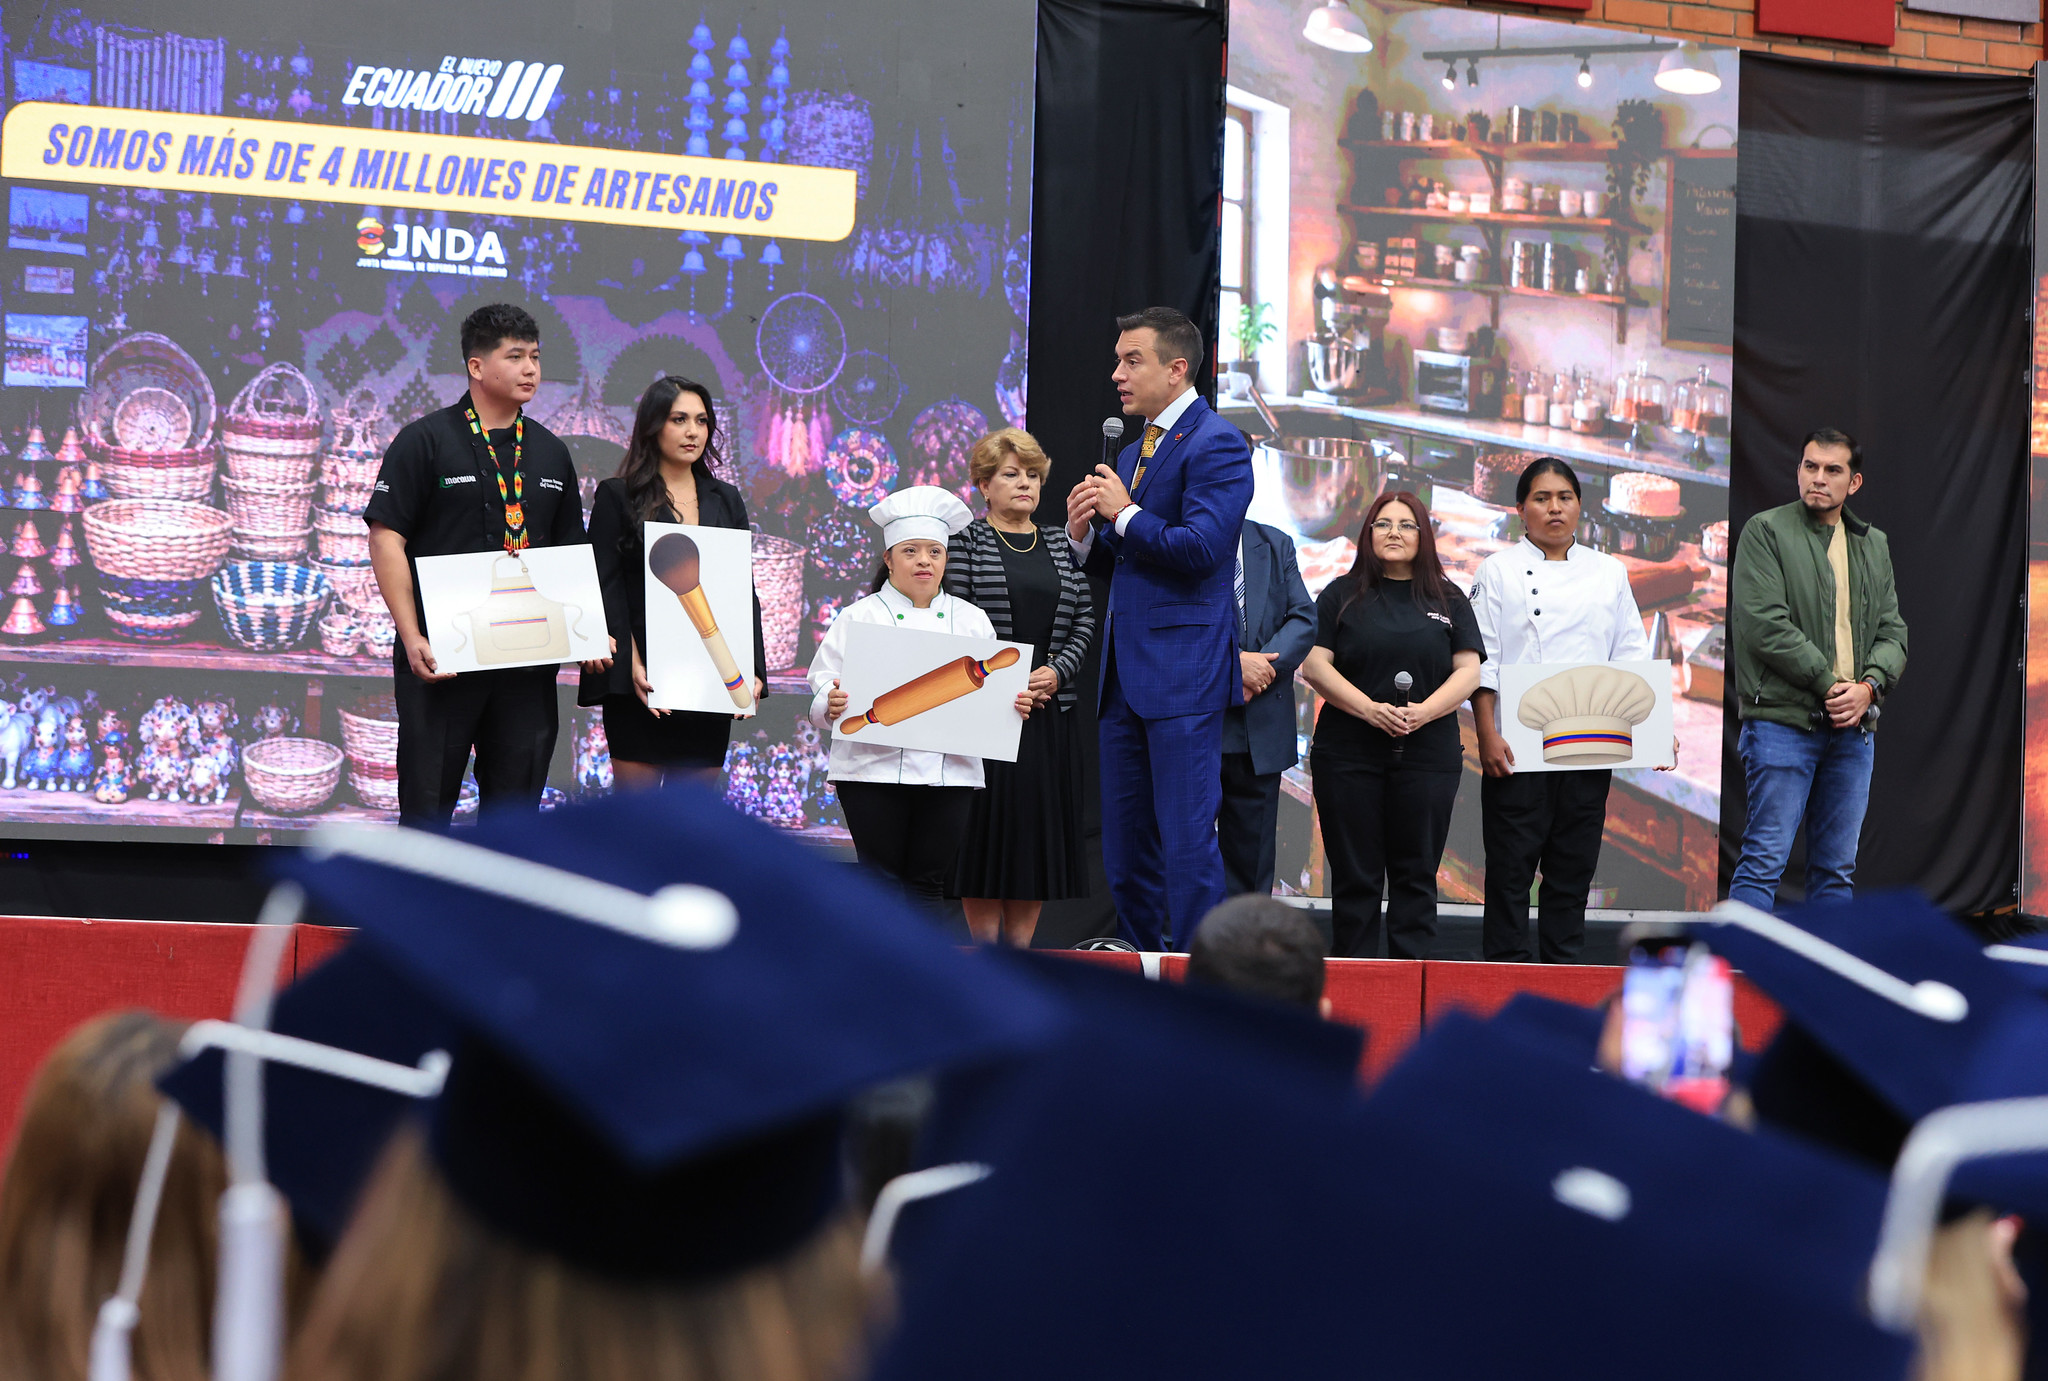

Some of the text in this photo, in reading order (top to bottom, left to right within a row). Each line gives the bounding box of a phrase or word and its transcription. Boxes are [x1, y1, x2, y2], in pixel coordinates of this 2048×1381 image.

[439, 56, 503, 77] EL NUEVO
[342, 65, 493, 116] ECUADOR
[43, 122, 778, 222] SOMOS MÁS DE 4 MILLONES DE ARTESANOS
[386, 223, 508, 266] JNDA
